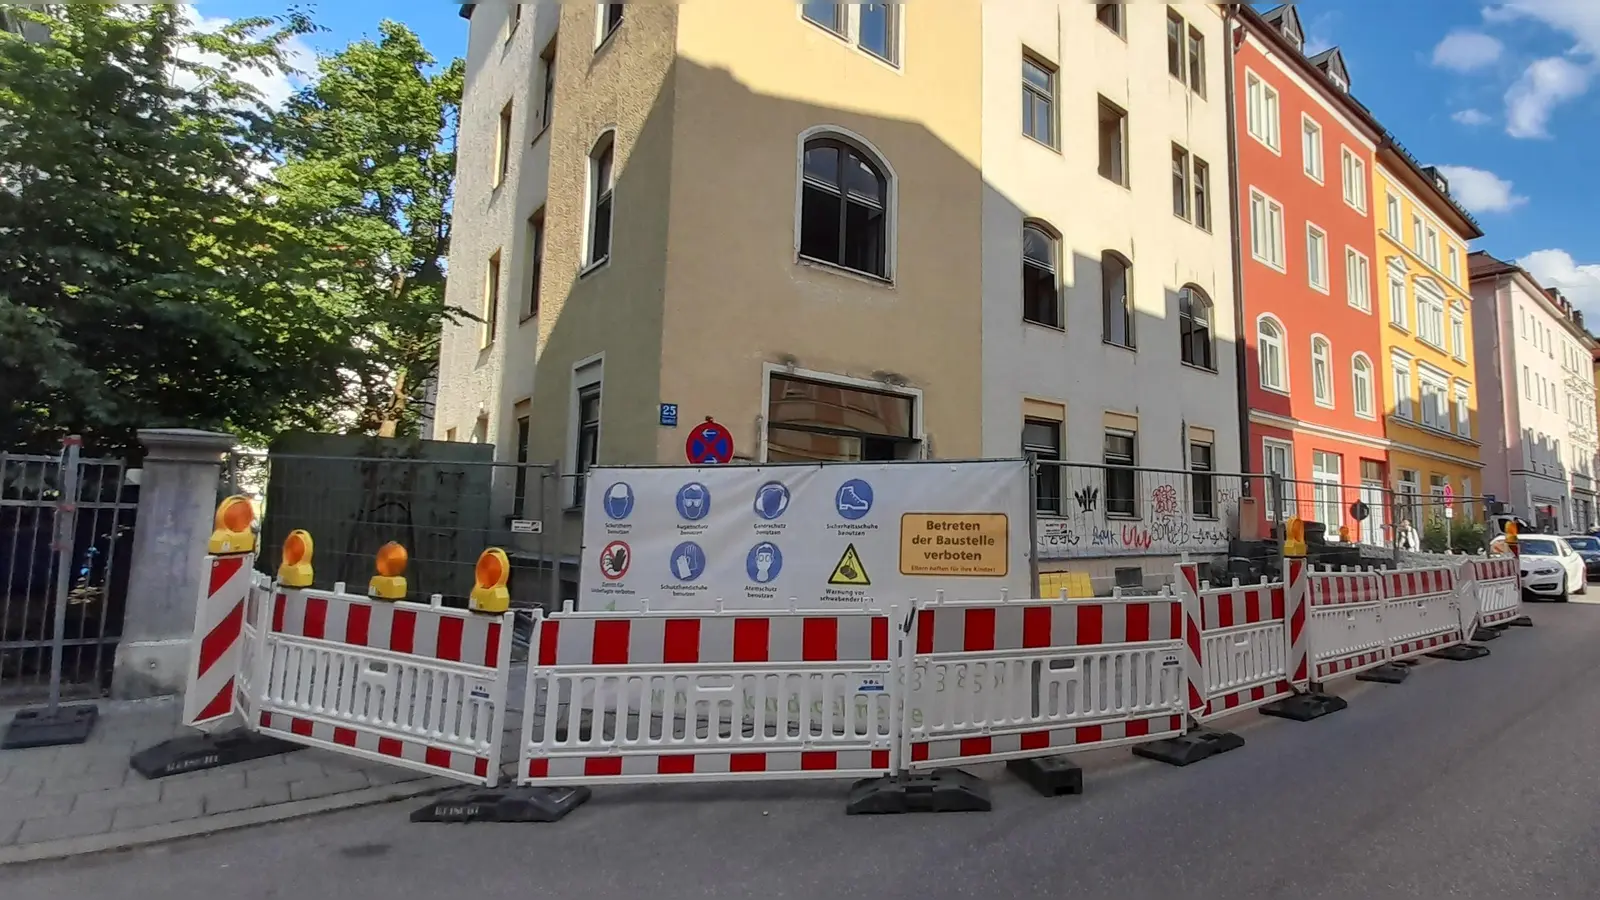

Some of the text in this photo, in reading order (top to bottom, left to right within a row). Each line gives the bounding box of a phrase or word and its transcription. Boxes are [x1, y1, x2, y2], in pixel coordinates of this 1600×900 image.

[663, 405, 677, 416] 25
[926, 520, 981, 531] Betreten
[911, 534, 996, 546] der Baustelle
[924, 550, 983, 561] verboten
[911, 564, 929, 572] Eltern
[929, 565, 949, 573] haften
[950, 565, 960, 573] für
[825, 588, 853, 596] Warnung
